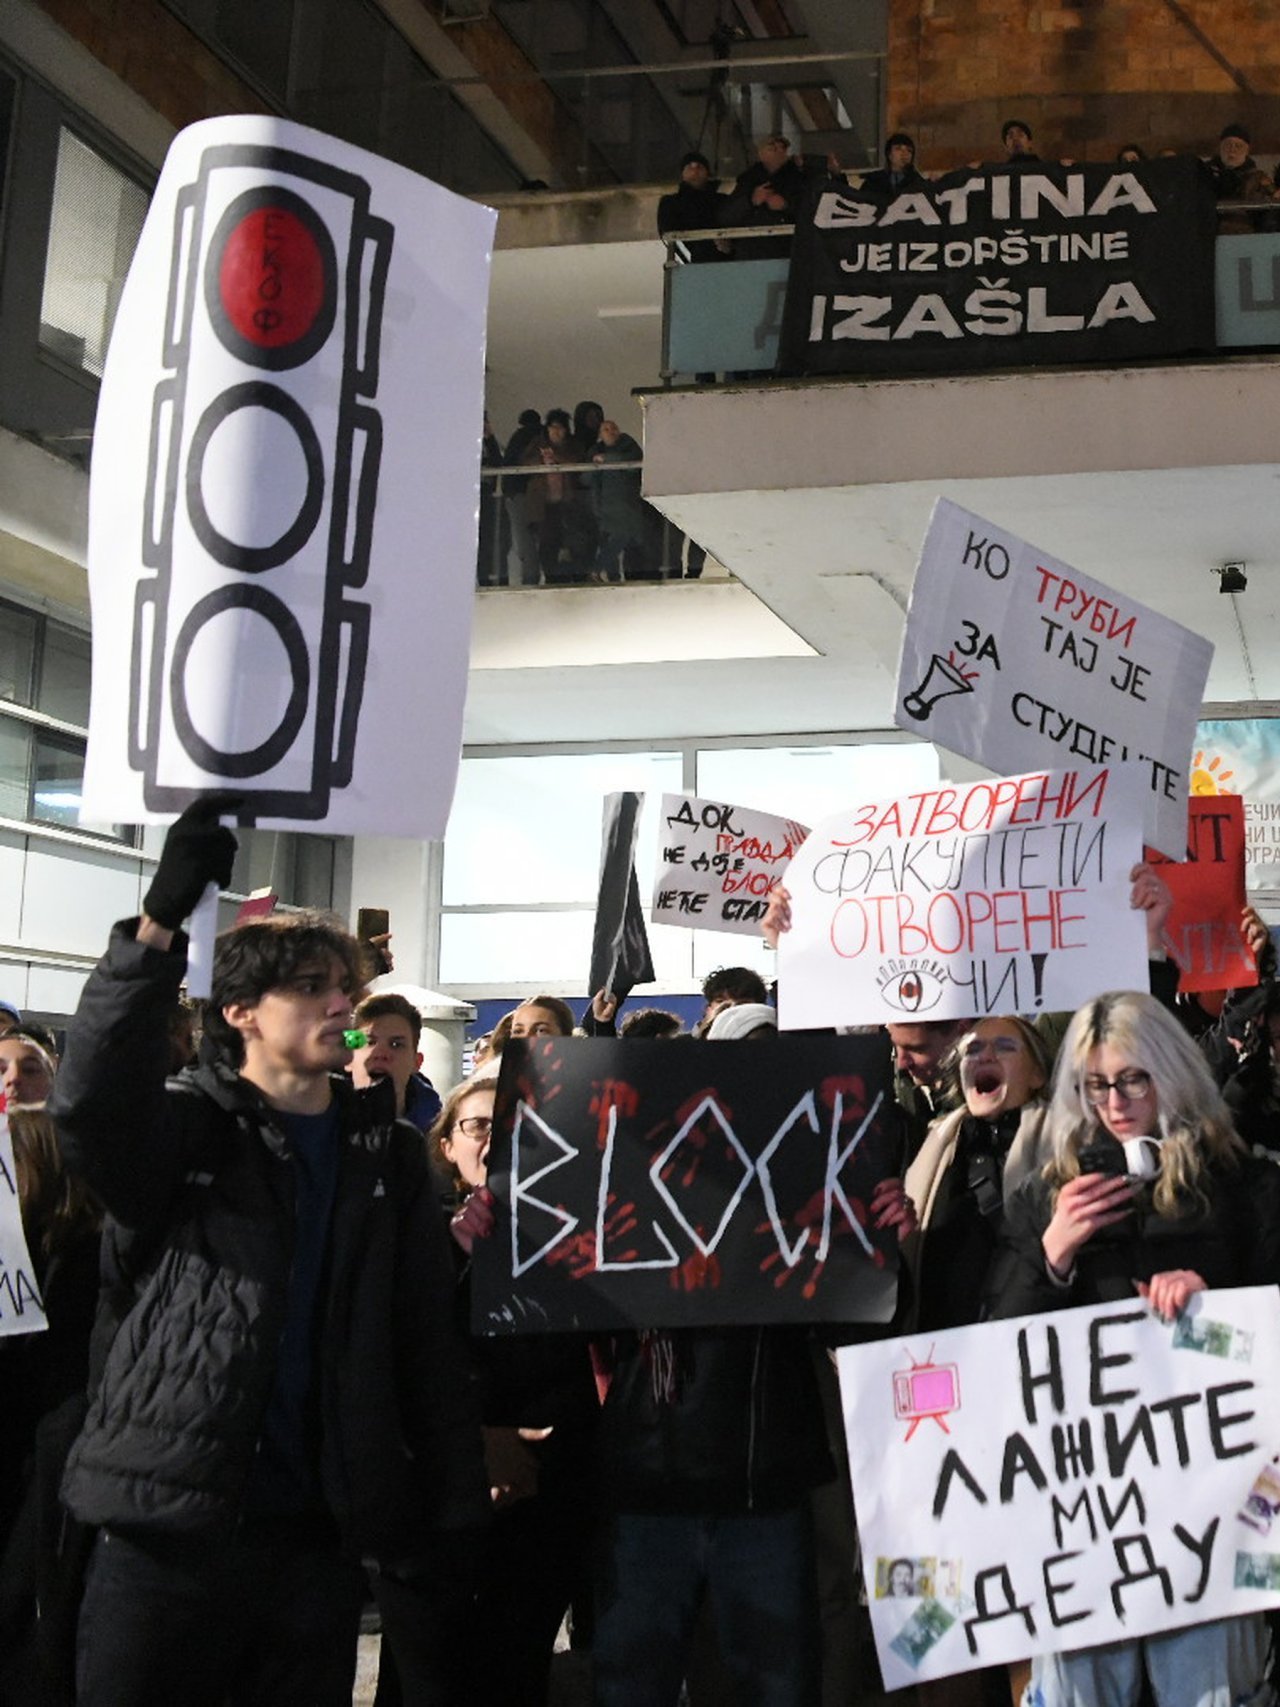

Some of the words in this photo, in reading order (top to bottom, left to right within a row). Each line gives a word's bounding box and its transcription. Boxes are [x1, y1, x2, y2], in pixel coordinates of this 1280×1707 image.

[813, 172, 1158, 229] BATINA
[840, 243, 893, 272] JE
[899, 242, 939, 271] IZ
[944, 229, 1129, 267] OPŠTINE
[808, 277, 1157, 341] IZAŠLA
[961, 531, 1010, 580] КО
[1036, 565, 1138, 648] ТРУБИ
[954, 620, 1001, 671] ЗА
[1040, 616, 1099, 673] ТАЈ
[1110, 656, 1151, 702] ЈЕ
[1010, 692, 1180, 801] СТУДЕТЕ
[666, 800, 745, 837] ДОК
[831, 769, 1109, 846] ЗАТВОРЕНИ
[663, 846, 686, 864] НЕ
[813, 821, 1107, 897] ФАКУЛТЕТИ
[830, 888, 1088, 958] ОТВОРЕНЕ
[510, 1088, 885, 1278] BLOCK
[1017, 1310, 1149, 1424] НЕ
[932, 1380, 1258, 1521] ЛАЖИТЕ
[1051, 1478, 1147, 1549] МИ
[963, 1516, 1220, 1657] ДЕДУ
